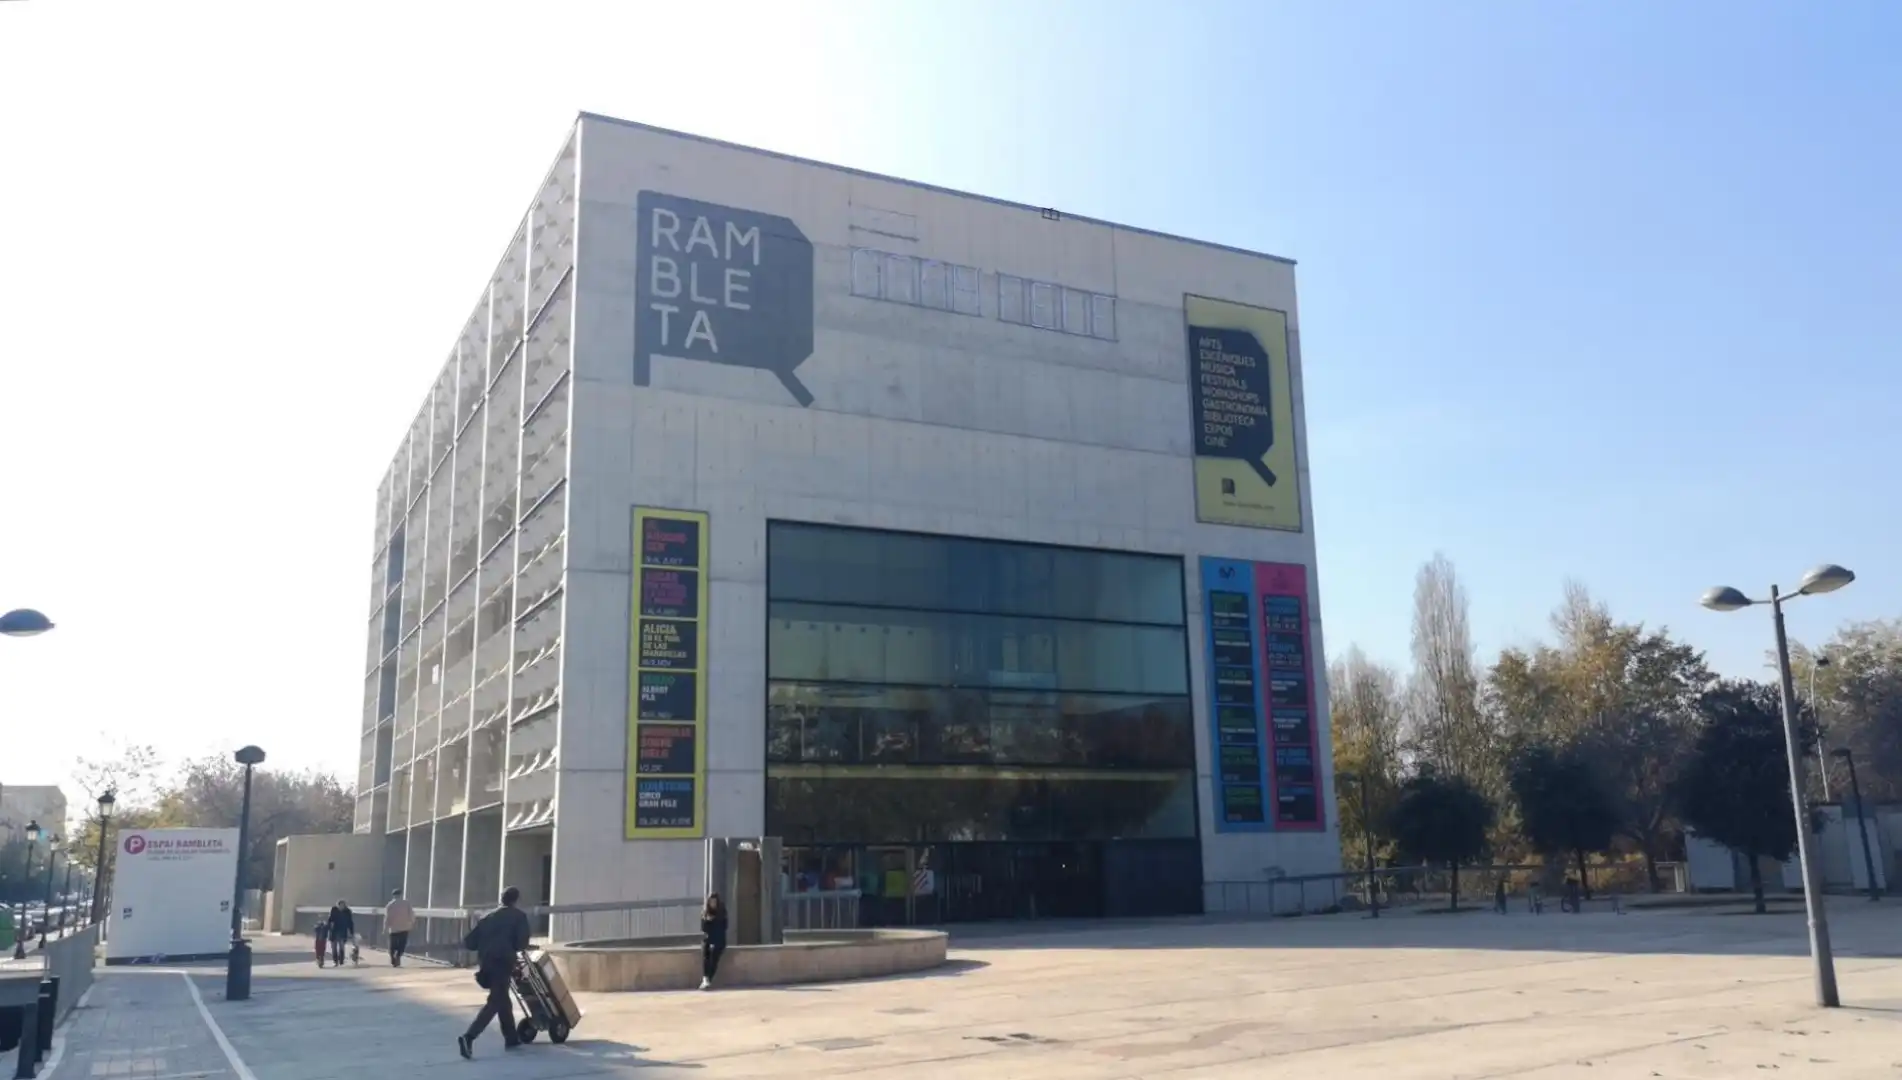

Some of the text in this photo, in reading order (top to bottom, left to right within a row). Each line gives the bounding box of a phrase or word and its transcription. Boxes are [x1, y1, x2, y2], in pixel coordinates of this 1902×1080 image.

[652, 207, 761, 266] RAM
[650, 254, 751, 310] BLE
[650, 303, 719, 353] TA
[1199, 336, 1222, 349] ARTS
[1201, 373, 1248, 391] FESTIVALS
[1201, 385, 1260, 404] WORKSHOPS
[1203, 410, 1256, 427] BIBLIOTECA
[1204, 423, 1233, 437] EXPOS
[643, 623, 677, 635] ALICIA
